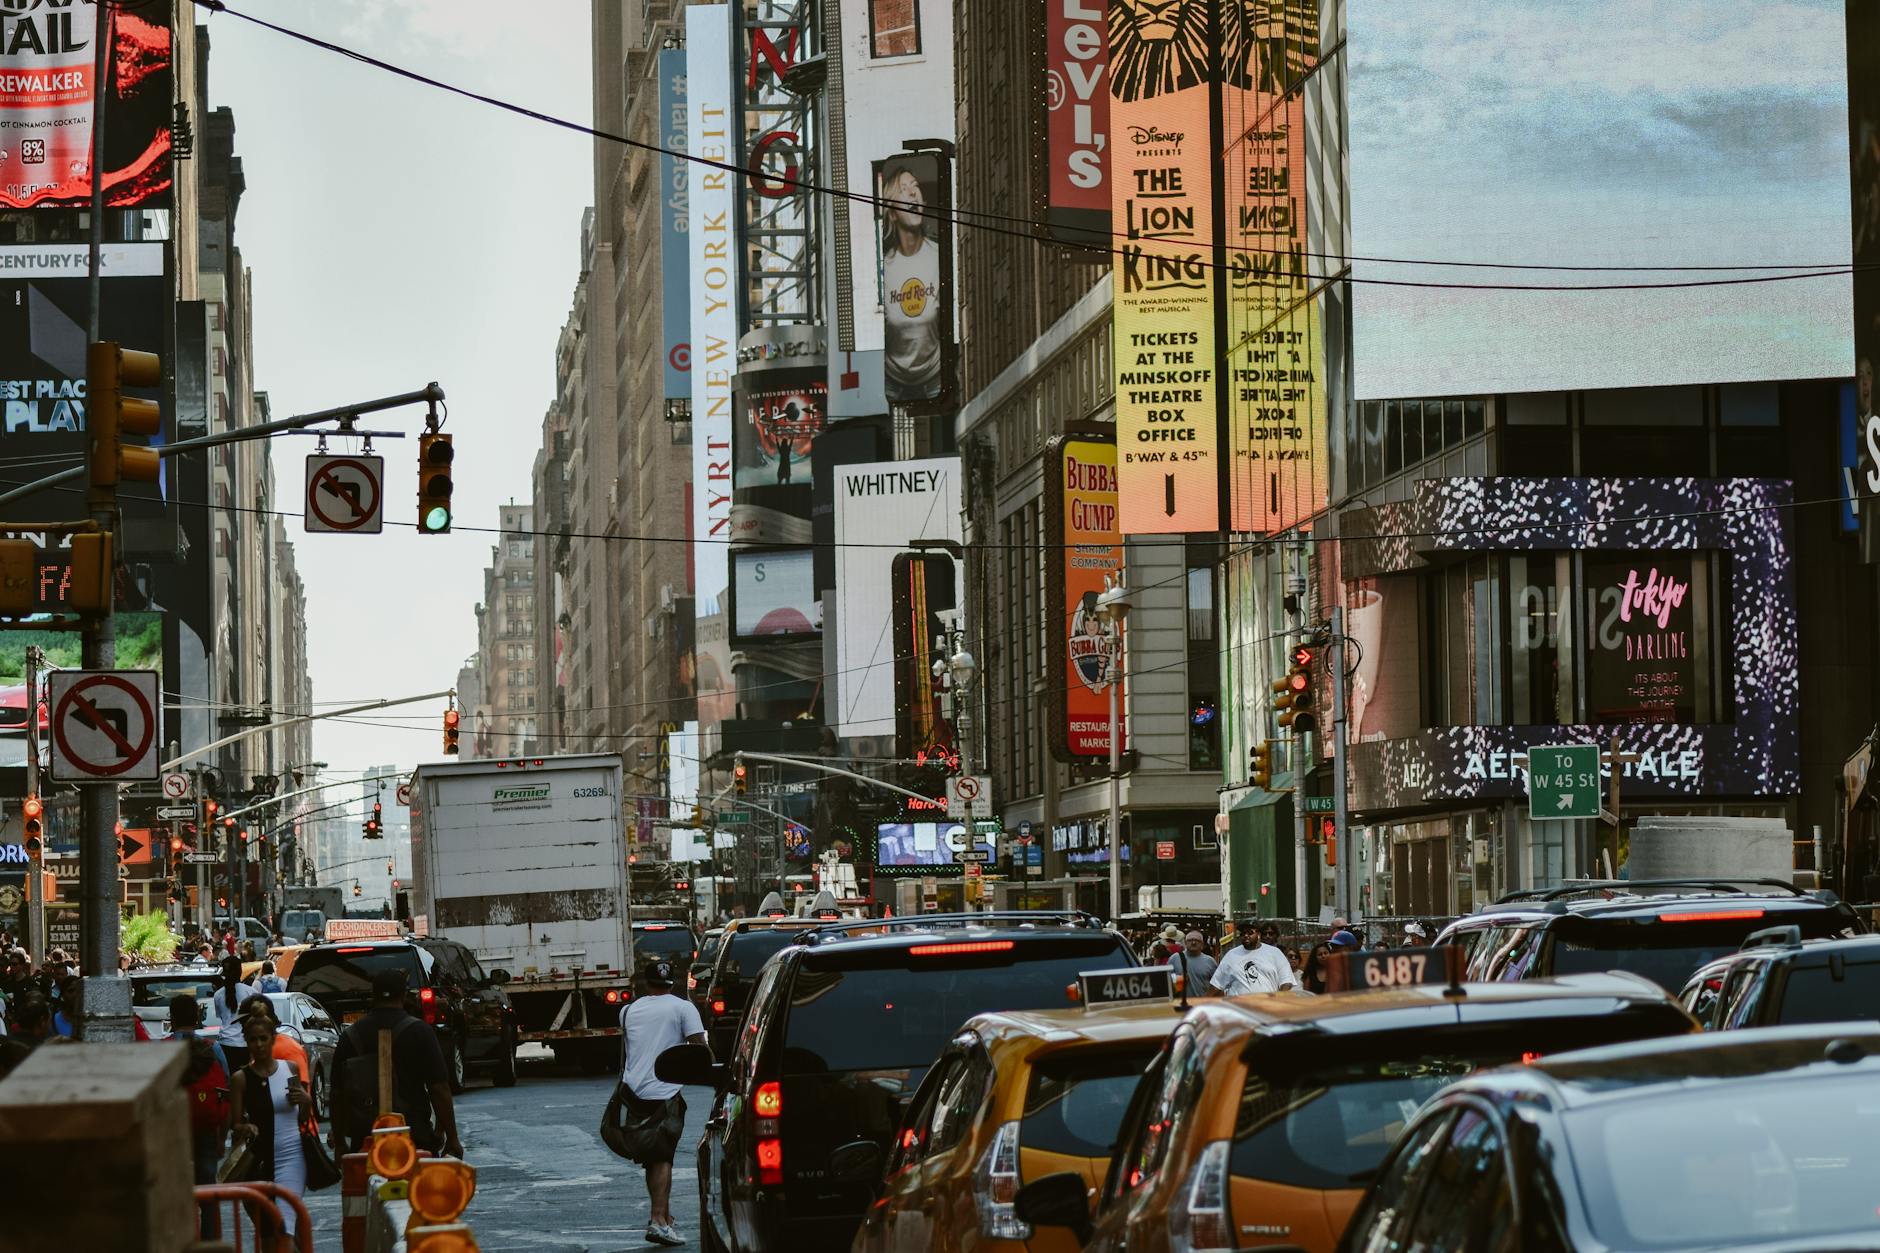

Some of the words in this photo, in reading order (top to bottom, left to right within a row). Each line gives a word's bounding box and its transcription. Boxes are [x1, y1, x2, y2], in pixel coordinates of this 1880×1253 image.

[12, 121, 52, 129] CINNAMON
[53, 116, 87, 127] COCKTAIL
[22, 141, 43, 156] 8%
[702, 102, 726, 191] REIT
[1136, 149, 1182, 157] PRESENTS
[1133, 168, 1182, 192] THE
[1126, 199, 1194, 240] LION
[0, 254, 72, 268] ENTURY
[703, 208, 728, 317] YORK
[1122, 244, 1206, 293] KING
[890, 288, 913, 304] Hard
[913, 281, 936, 300] Rock
[1140, 297, 1208, 305] AWARD-WINNING
[1131, 332, 1198, 347] TICKETS
[1136, 353, 1155, 365] AT
[1163, 352, 1194, 364] THE
[706, 333, 730, 418] NEW
[1120, 370, 1211, 385] MINSKOFF
[36, 380, 86, 398] PLAC
[1129, 390, 1202, 404] THEATRE
[1147, 409, 1185, 422] BOX
[1137, 428, 1195, 442] OFFICE
[1126, 452, 1165, 463] B'WAY
[1170, 452, 1178, 462] &
[1067, 456, 1118, 491] BUBBA
[707, 435, 731, 539] NYRT
[846, 470, 940, 497] WHITNEY
[1072, 498, 1115, 531] GUMP
[1071, 557, 1117, 569] COMPANY
[1617, 568, 1687, 629] tokyo
[1071, 639, 1096, 656] BUBBA
[1626, 632, 1686, 661] DARLING
[1651, 672, 1678, 683] ABOUT
[1628, 687, 1644, 697] THE
[1648, 685, 1683, 697] JOURNEY
[1070, 721, 1125, 733] RESTAURAT
[1080, 737, 1111, 749] MARKE
[1555, 755, 1573, 769] To
[1534, 775, 1549, 788] W
[1555, 774, 1574, 788] 45
[1579, 773, 1594, 787] St
[494, 788, 550, 799] Premier
[573, 787, 604, 798] 63269
[1311, 799, 1320, 809] W
[1321, 798, 1332, 808] 45
[50, 932, 80, 941] EMP
[1365, 955, 1426, 986] 6J87
[1103, 975, 1153, 998] 4A64
